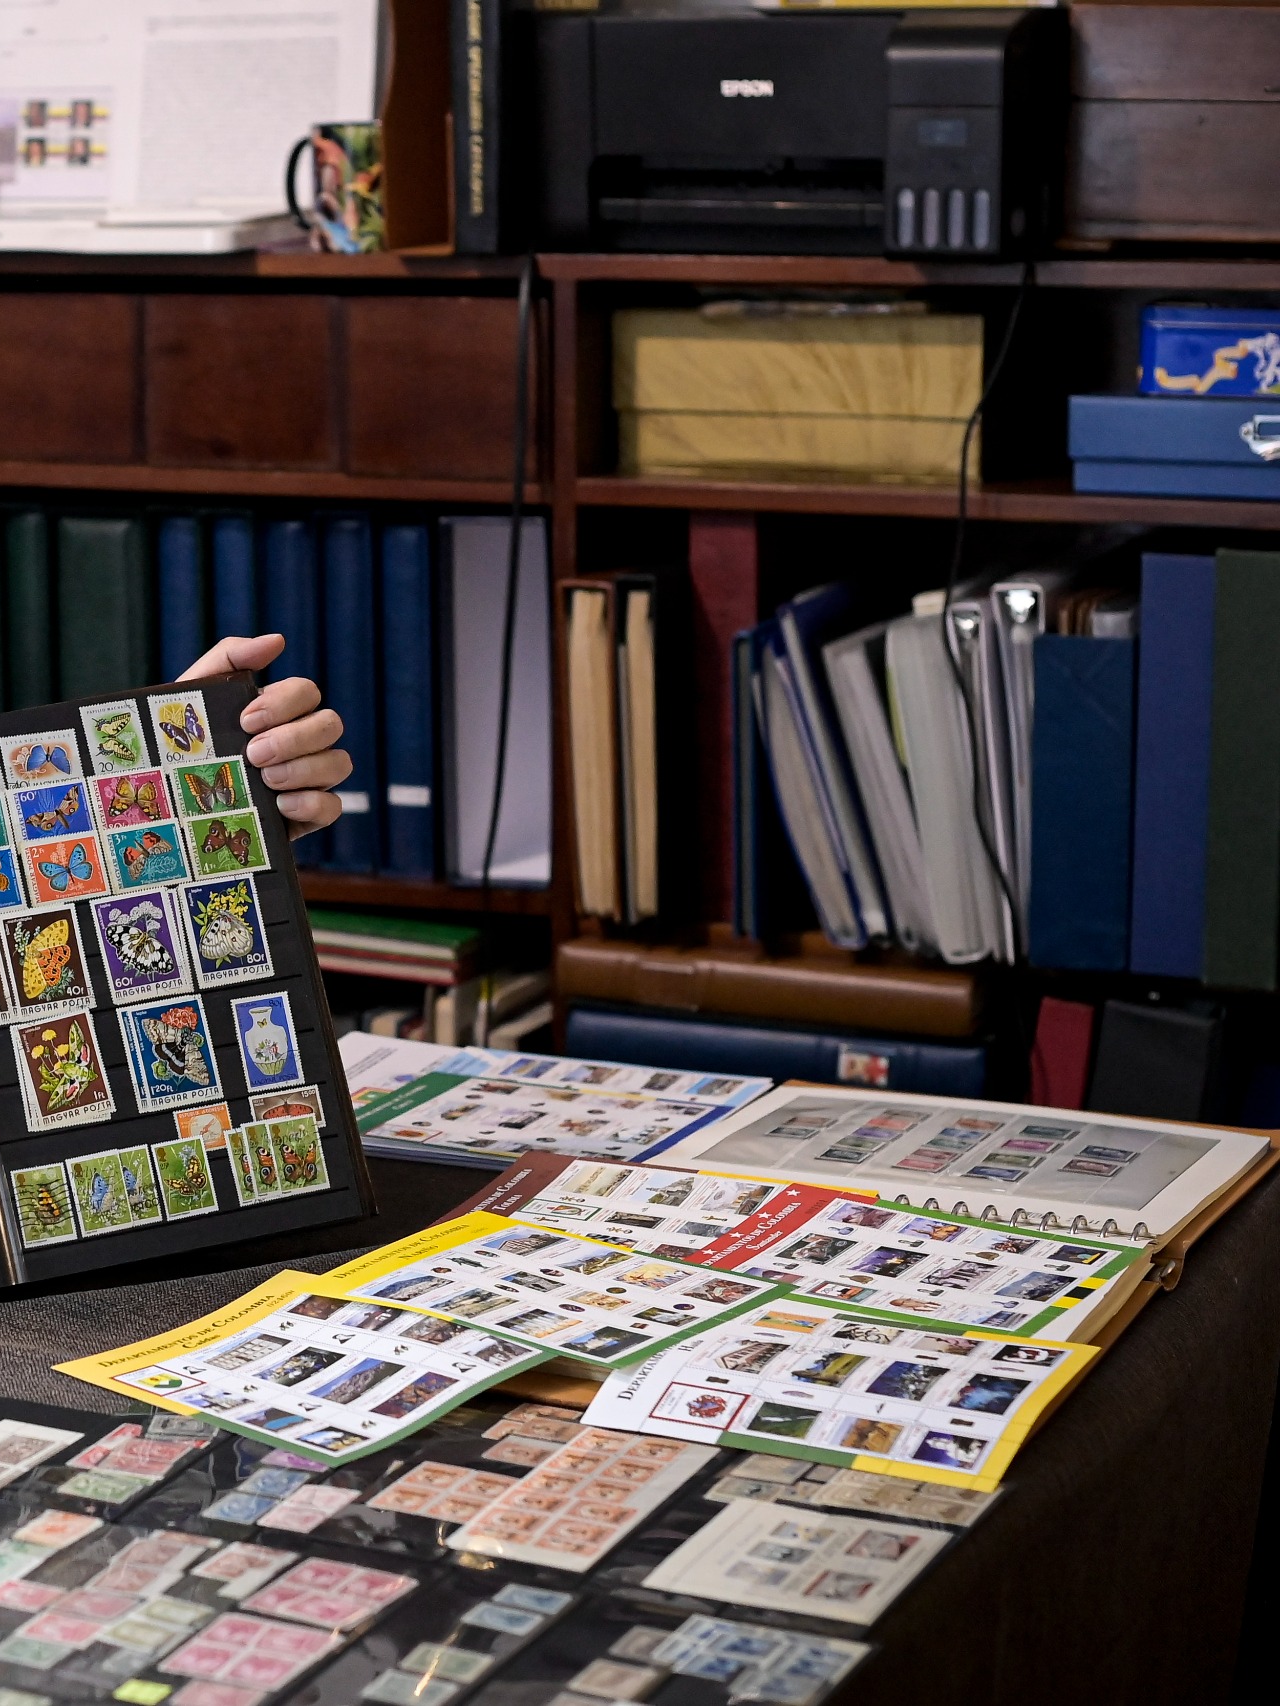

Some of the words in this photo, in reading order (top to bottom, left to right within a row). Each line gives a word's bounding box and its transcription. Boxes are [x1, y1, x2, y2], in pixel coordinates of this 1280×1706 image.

[721, 79, 774, 97] EPSON
[92, 779, 101, 801] POSTA
[172, 768, 182, 791] POSTA
[13, 792, 24, 817] POSTA
[187, 820, 197, 845] POSTA
[107, 833, 117, 860] POSTA
[25, 847, 35, 873] POSTA
[192, 845, 204, 876] MAGYAR
[111, 860, 124, 889] MAGYAR
[30, 872, 42, 903] MAGYAR
[246, 954, 266, 965] 80f
[114, 977, 133, 989] 60f
[203, 969, 240, 982] MAGYAR
[242, 964, 271, 976] POSTA
[115, 984, 153, 999] MAGYAR
[155, 978, 184, 990] POSTA
[21, 1000, 59, 1016] MAGYAR
[62, 996, 91, 1008] POSTA
[150, 1092, 189, 1107] MAGYAR
[191, 1086, 220, 1099] POSTA
[42, 1109, 81, 1126] MAGYAR
[83, 1100, 113, 1114] POSTA
[496, 1168, 533, 1192] COLOMBIA
[491, 1193, 523, 1211] TOLIMA
[757, 1202, 802, 1231] COLOMBIA
[333, 1245, 411, 1279] DEPARTAMENTOS
[419, 1223, 471, 1246] COLOMBIA
[745, 1230, 784, 1251] Santander
[97, 1332, 199, 1368] DEPARTAMENTOS
[198, 1327, 215, 1336] DE
[212, 1294, 276, 1329] COLOMBIA
[181, 1334, 221, 1350] Caldas
